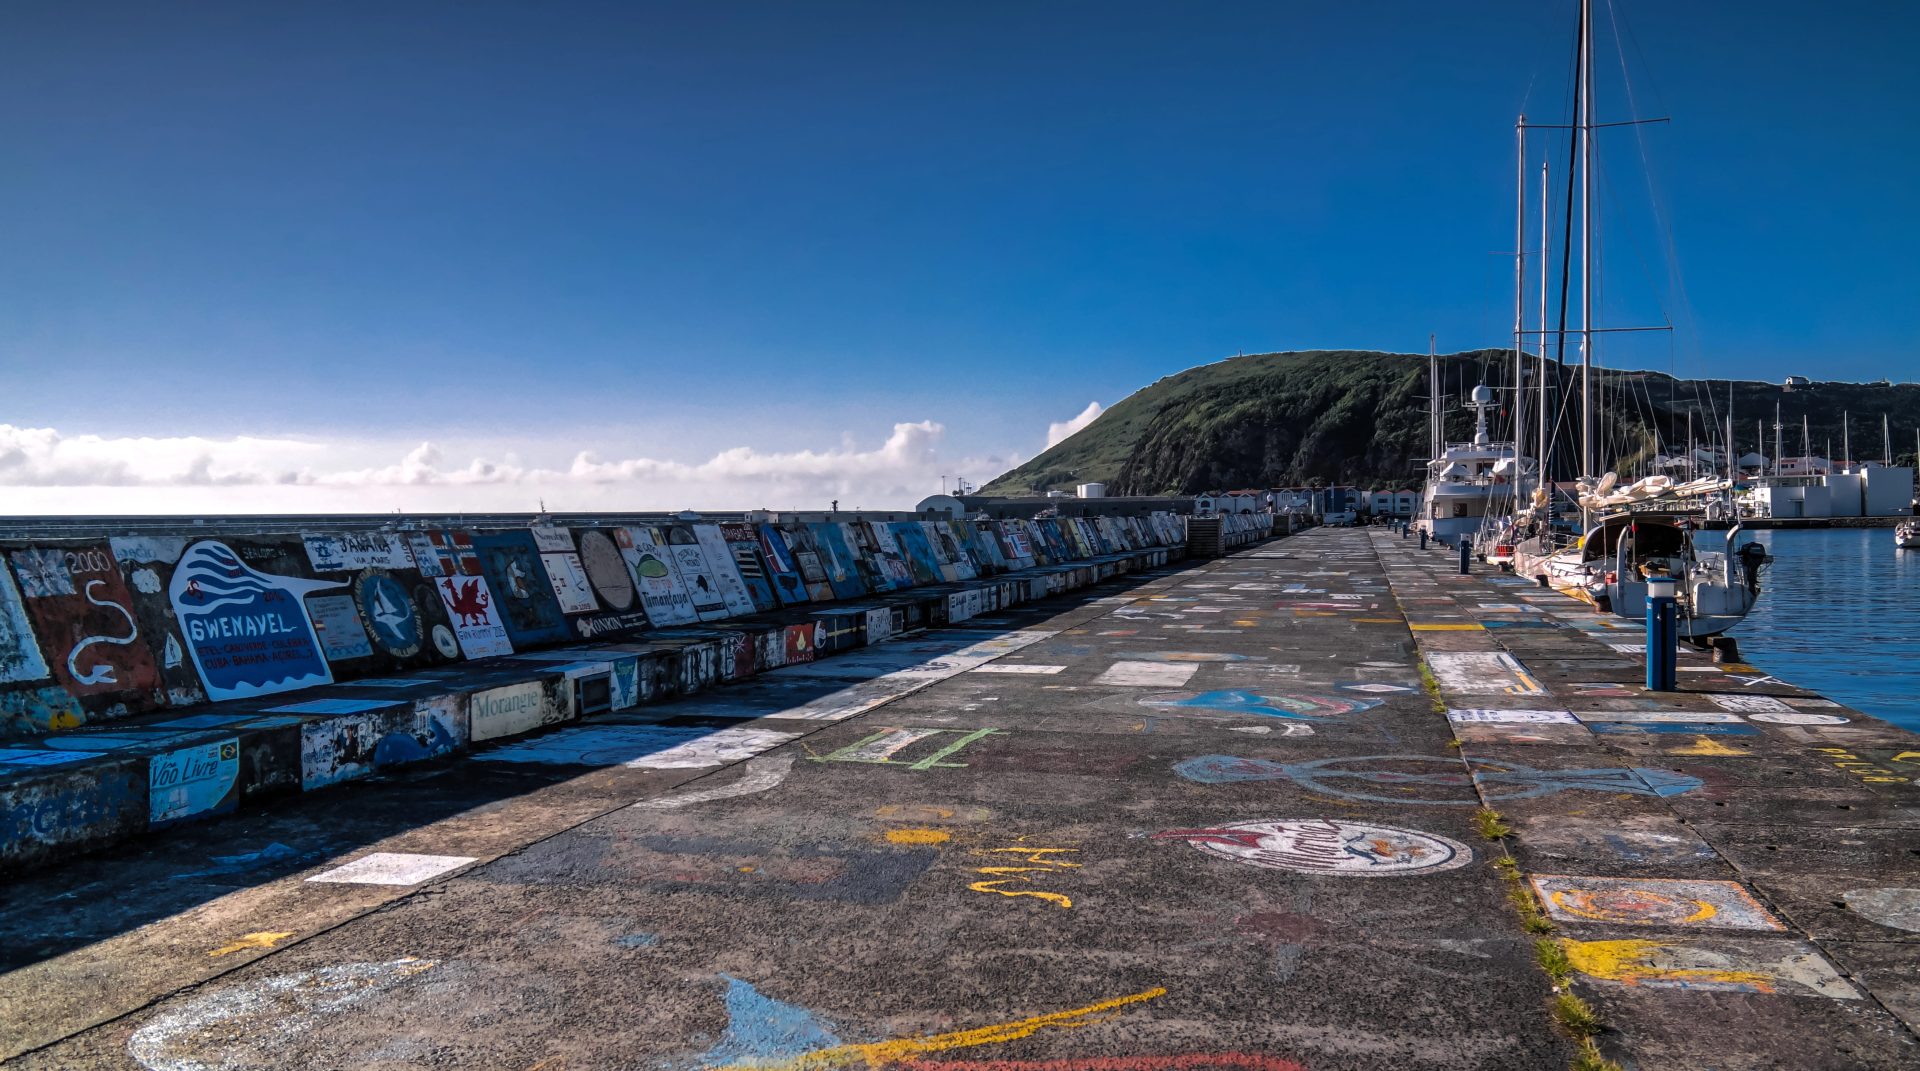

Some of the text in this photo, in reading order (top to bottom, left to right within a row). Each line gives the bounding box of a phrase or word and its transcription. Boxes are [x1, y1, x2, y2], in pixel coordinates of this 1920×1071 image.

[65, 551, 111, 574] 2000
[189, 613, 298, 641] GWENAVEL
[475, 691, 538, 719] Morangie
[182, 757, 218, 781] Livre
